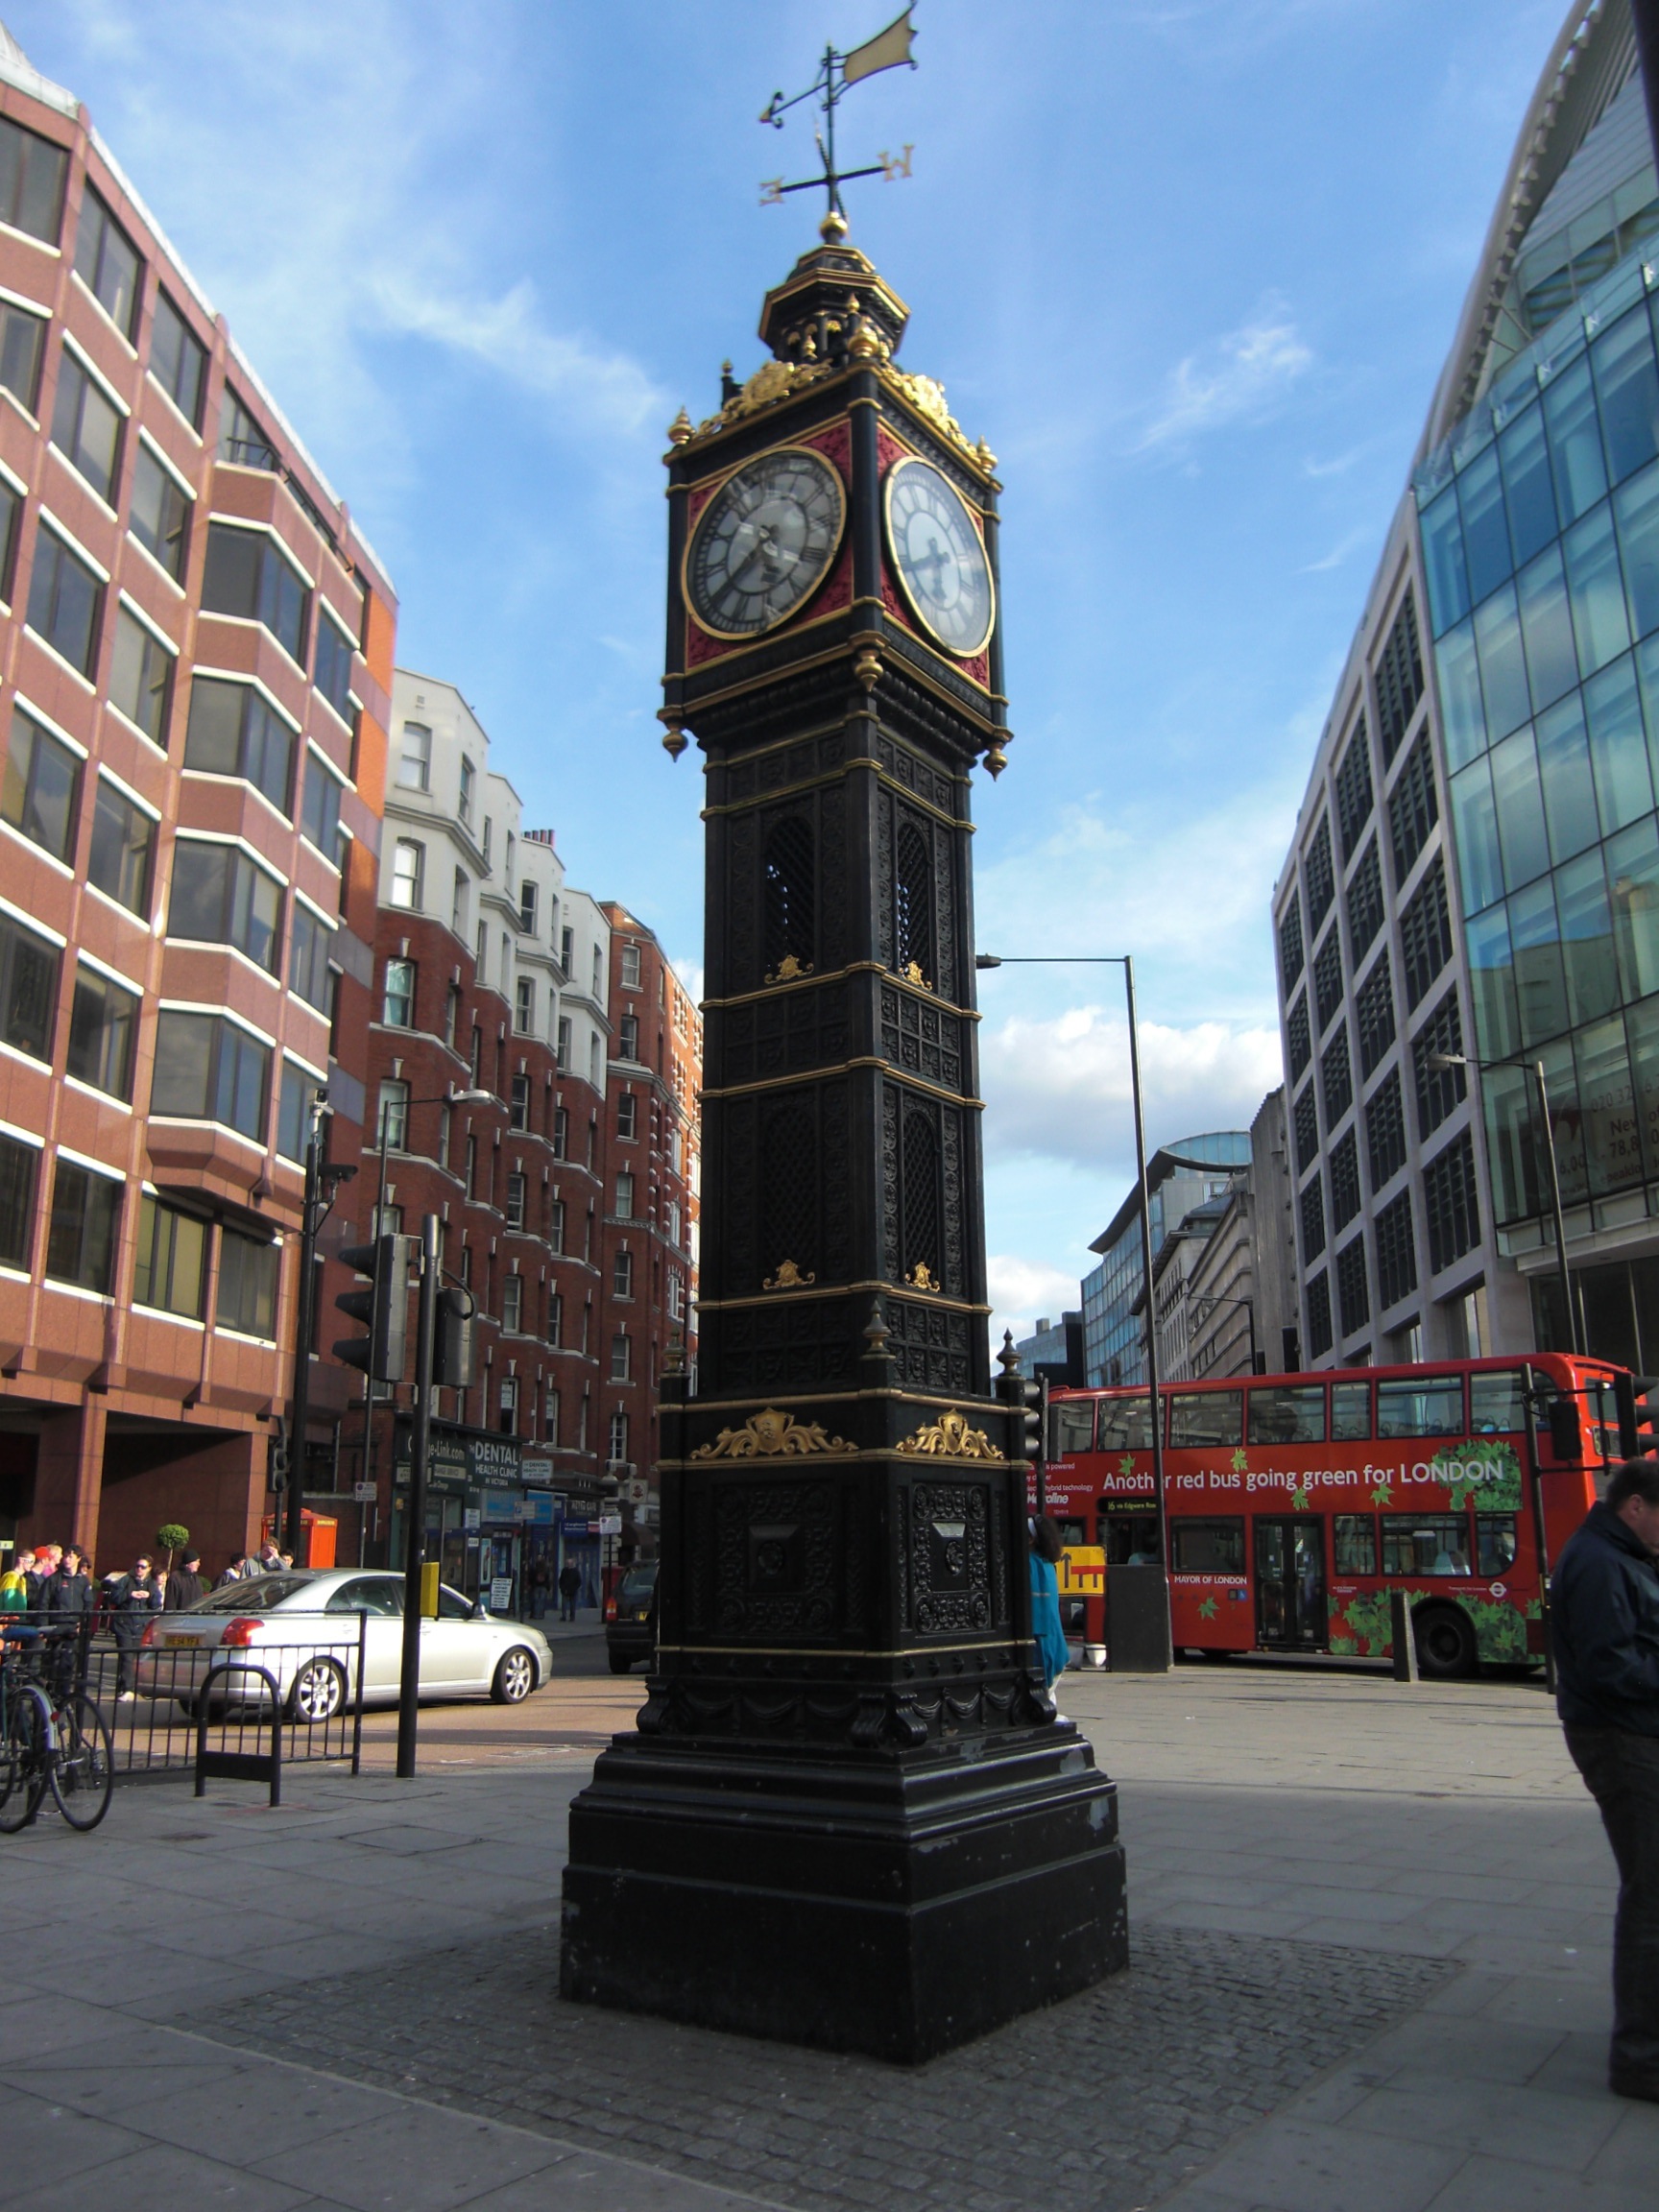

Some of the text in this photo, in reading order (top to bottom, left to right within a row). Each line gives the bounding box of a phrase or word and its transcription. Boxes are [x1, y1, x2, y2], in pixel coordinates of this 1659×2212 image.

[475, 1440, 518, 1465] DENTAL
[475, 1463, 498, 1477] HEALTH
[499, 1466, 517, 1479] CLINIC
[1051, 1462, 1075, 1471] powered
[1103, 1459, 1503, 1492] Anothr red bus going green for LONDON
[1108, 1501, 1115, 1510] 16
[1214, 1575, 1247, 1585] LONDON
